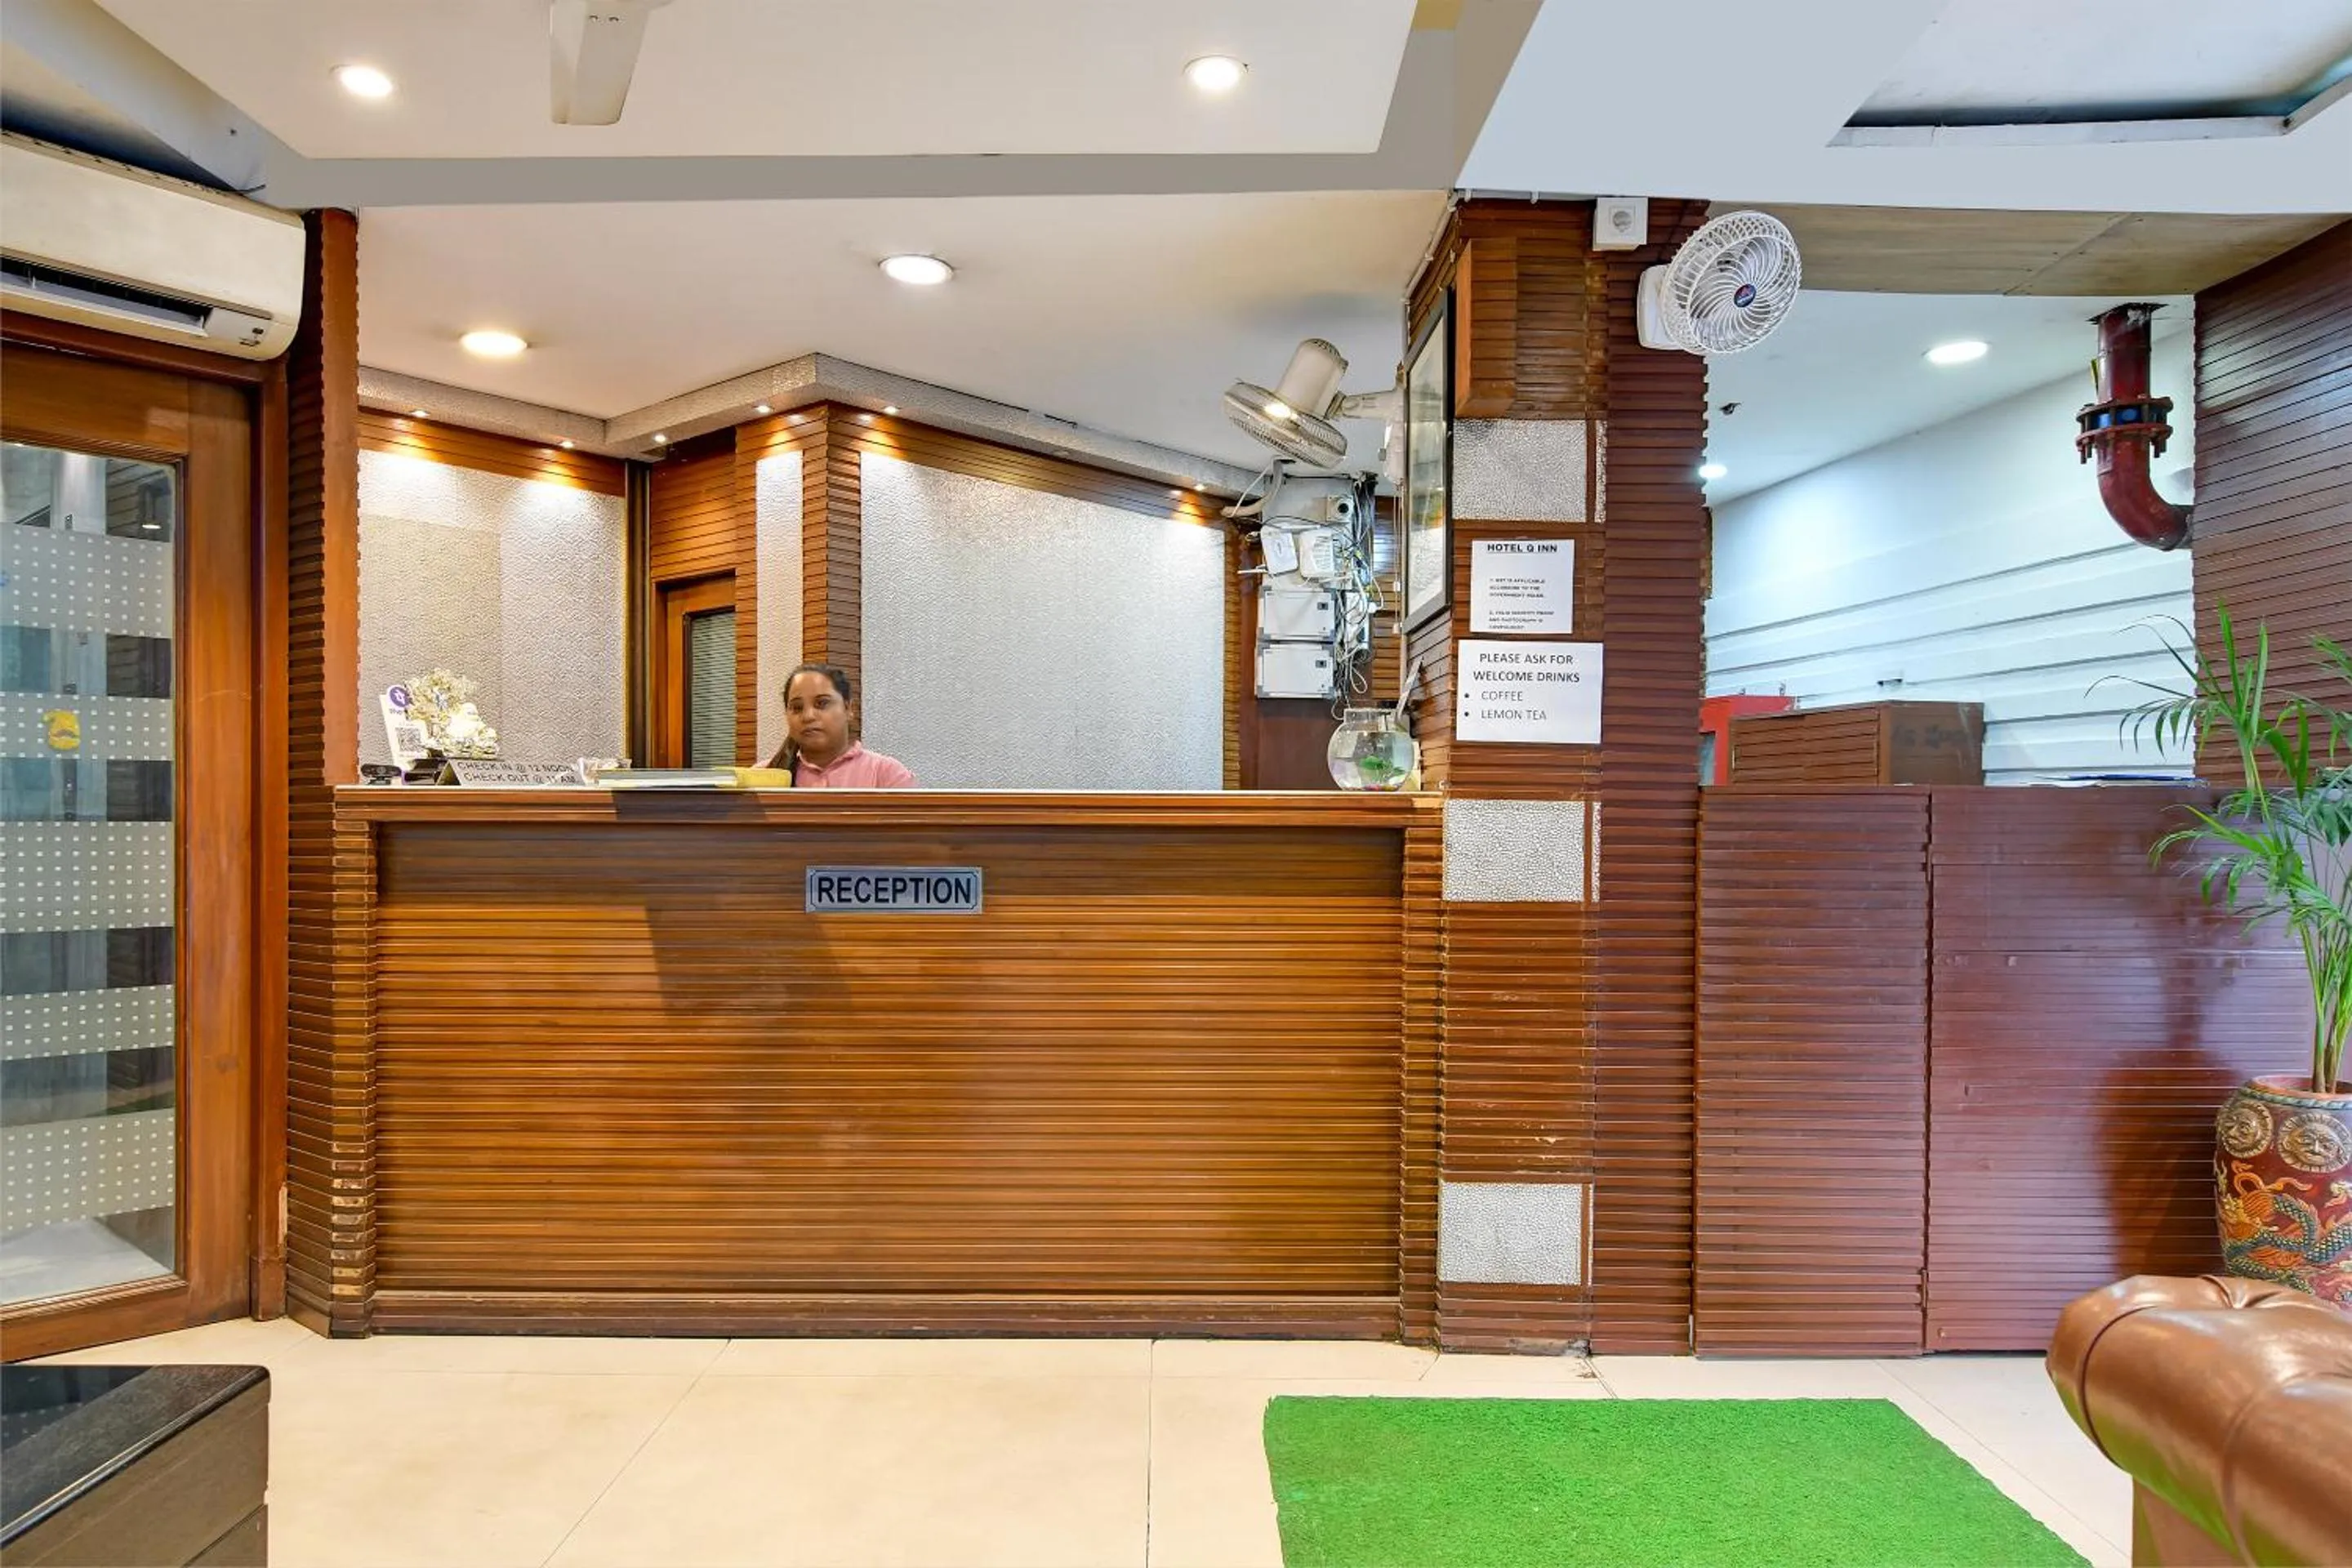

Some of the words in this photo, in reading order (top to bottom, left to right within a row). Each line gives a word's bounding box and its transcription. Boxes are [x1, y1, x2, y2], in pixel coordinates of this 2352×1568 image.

[1487, 543, 1523, 552] HOTEL
[1526, 544, 1535, 552] Q
[1537, 545, 1557, 553] INN
[1479, 653, 1521, 664] PLEASE
[1524, 654, 1547, 664] ASK
[1550, 655, 1573, 665] FOR
[1473, 670, 1533, 681] WELCOME
[1537, 672, 1580, 683] DRINKS
[1481, 691, 1523, 701] COFFEE
[1481, 710, 1521, 719] LEMON
[1526, 710, 1547, 720] TEA
[457, 761, 498, 770] CHECK
[500, 763, 511, 771] IN
[464, 773, 505, 782] CHECK
[817, 876, 972, 904] RECEPTION
